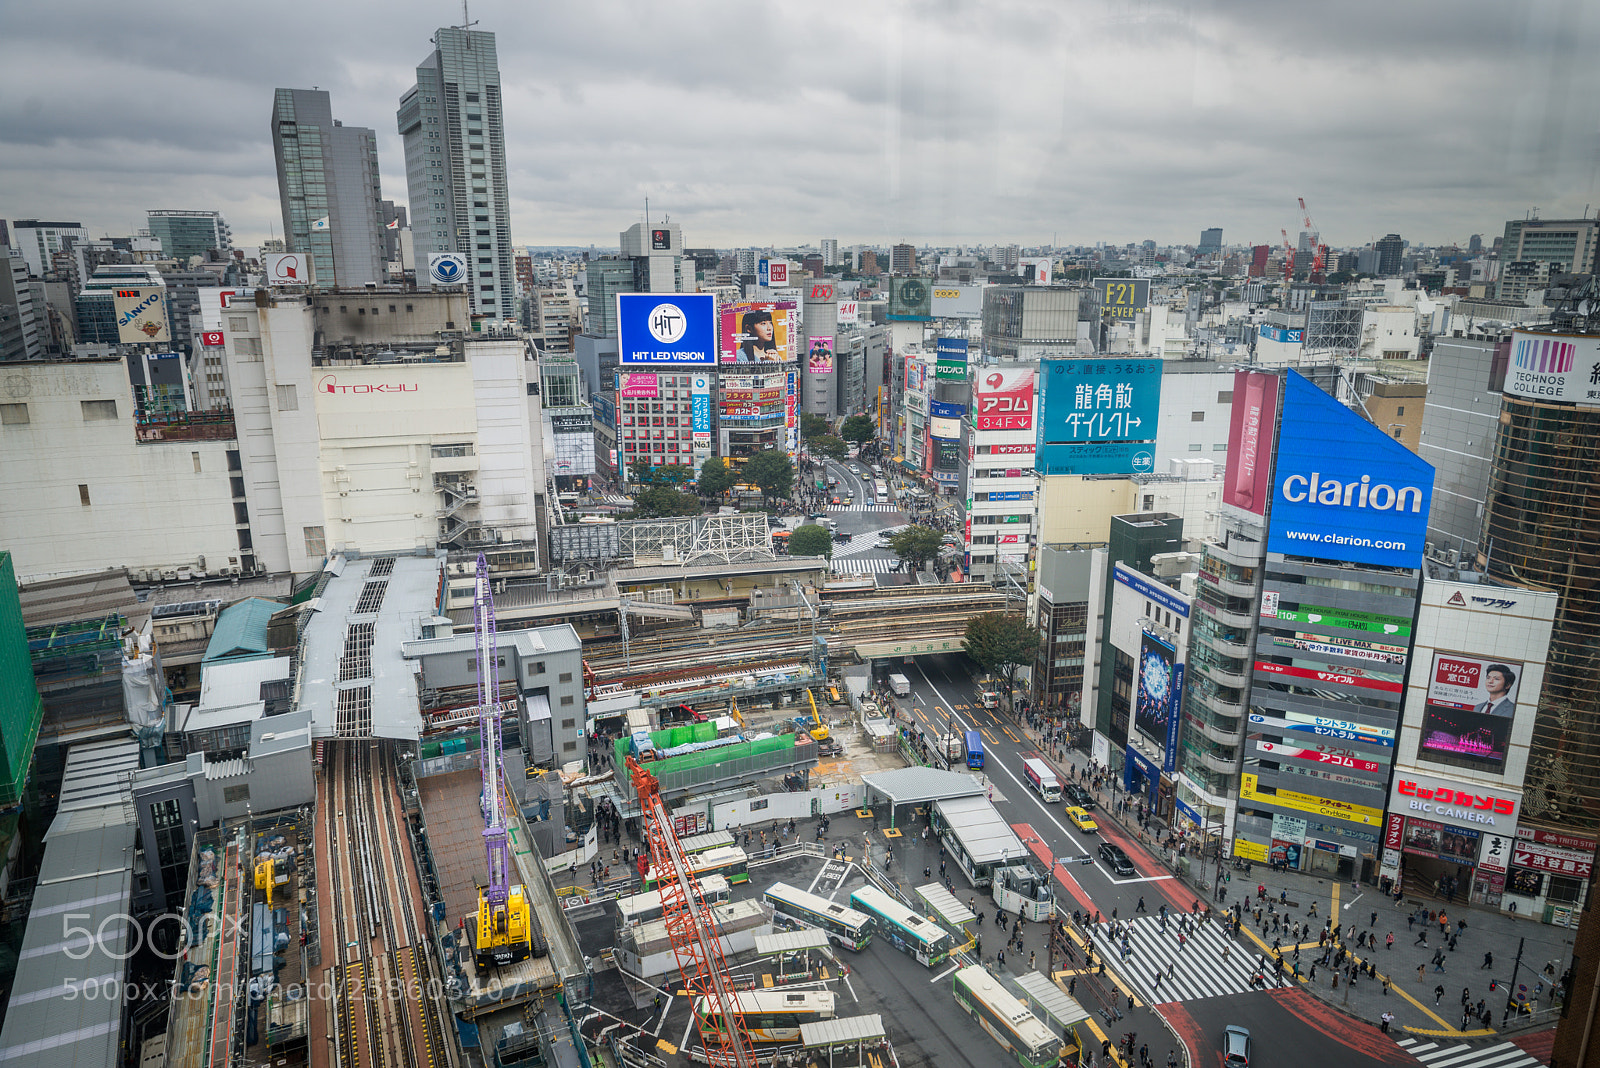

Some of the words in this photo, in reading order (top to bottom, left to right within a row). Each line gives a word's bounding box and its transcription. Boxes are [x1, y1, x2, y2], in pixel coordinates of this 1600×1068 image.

[810, 287, 834, 302] 109
[1106, 283, 1135, 305] F21
[118, 294, 158, 326] SANKYO
[632, 351, 649, 360] HIT
[651, 351, 671, 360] LED
[672, 351, 705, 360] VISION
[938, 366, 964, 374] サロンパス
[1516, 372, 1565, 385] TECHNOS
[336, 383, 418, 394] TOKYU
[1514, 383, 1564, 396] COLLEGE
[1075, 383, 1133, 409] 龍角散
[982, 397, 1029, 412] アコム
[694, 397, 702, 430] アイシティ
[1286, 530, 1406, 550] www.clarion.com
[1282, 612, 1297, 620] 10F
[1354, 640, 1372, 648] MAX
[1336, 665, 1364, 676] アイフル
[1440, 662, 1478, 675] ほけんの
[1326, 674, 1354, 684] アイフル
[1447, 673, 1466, 683] 窓口
[1315, 717, 1356, 730] セントラル
[1314, 726, 1355, 740] セントラル
[1328, 746, 1355, 758] アコム
[1319, 753, 1354, 767] アコム
[1398, 780, 1514, 815] ビックカメラ
[1320, 799, 1352, 810] シティホーム
[1184, 807, 1192, 816] DHC
[1320, 808, 1351, 819] CityHome
[1409, 800, 1432, 812] BIC
[1435, 806, 1496, 825] CAMERA
[1388, 816, 1401, 844] カラオケ
[1559, 838, 1578, 846] TAITO
[1533, 854, 1591, 874] 渋谷最大
